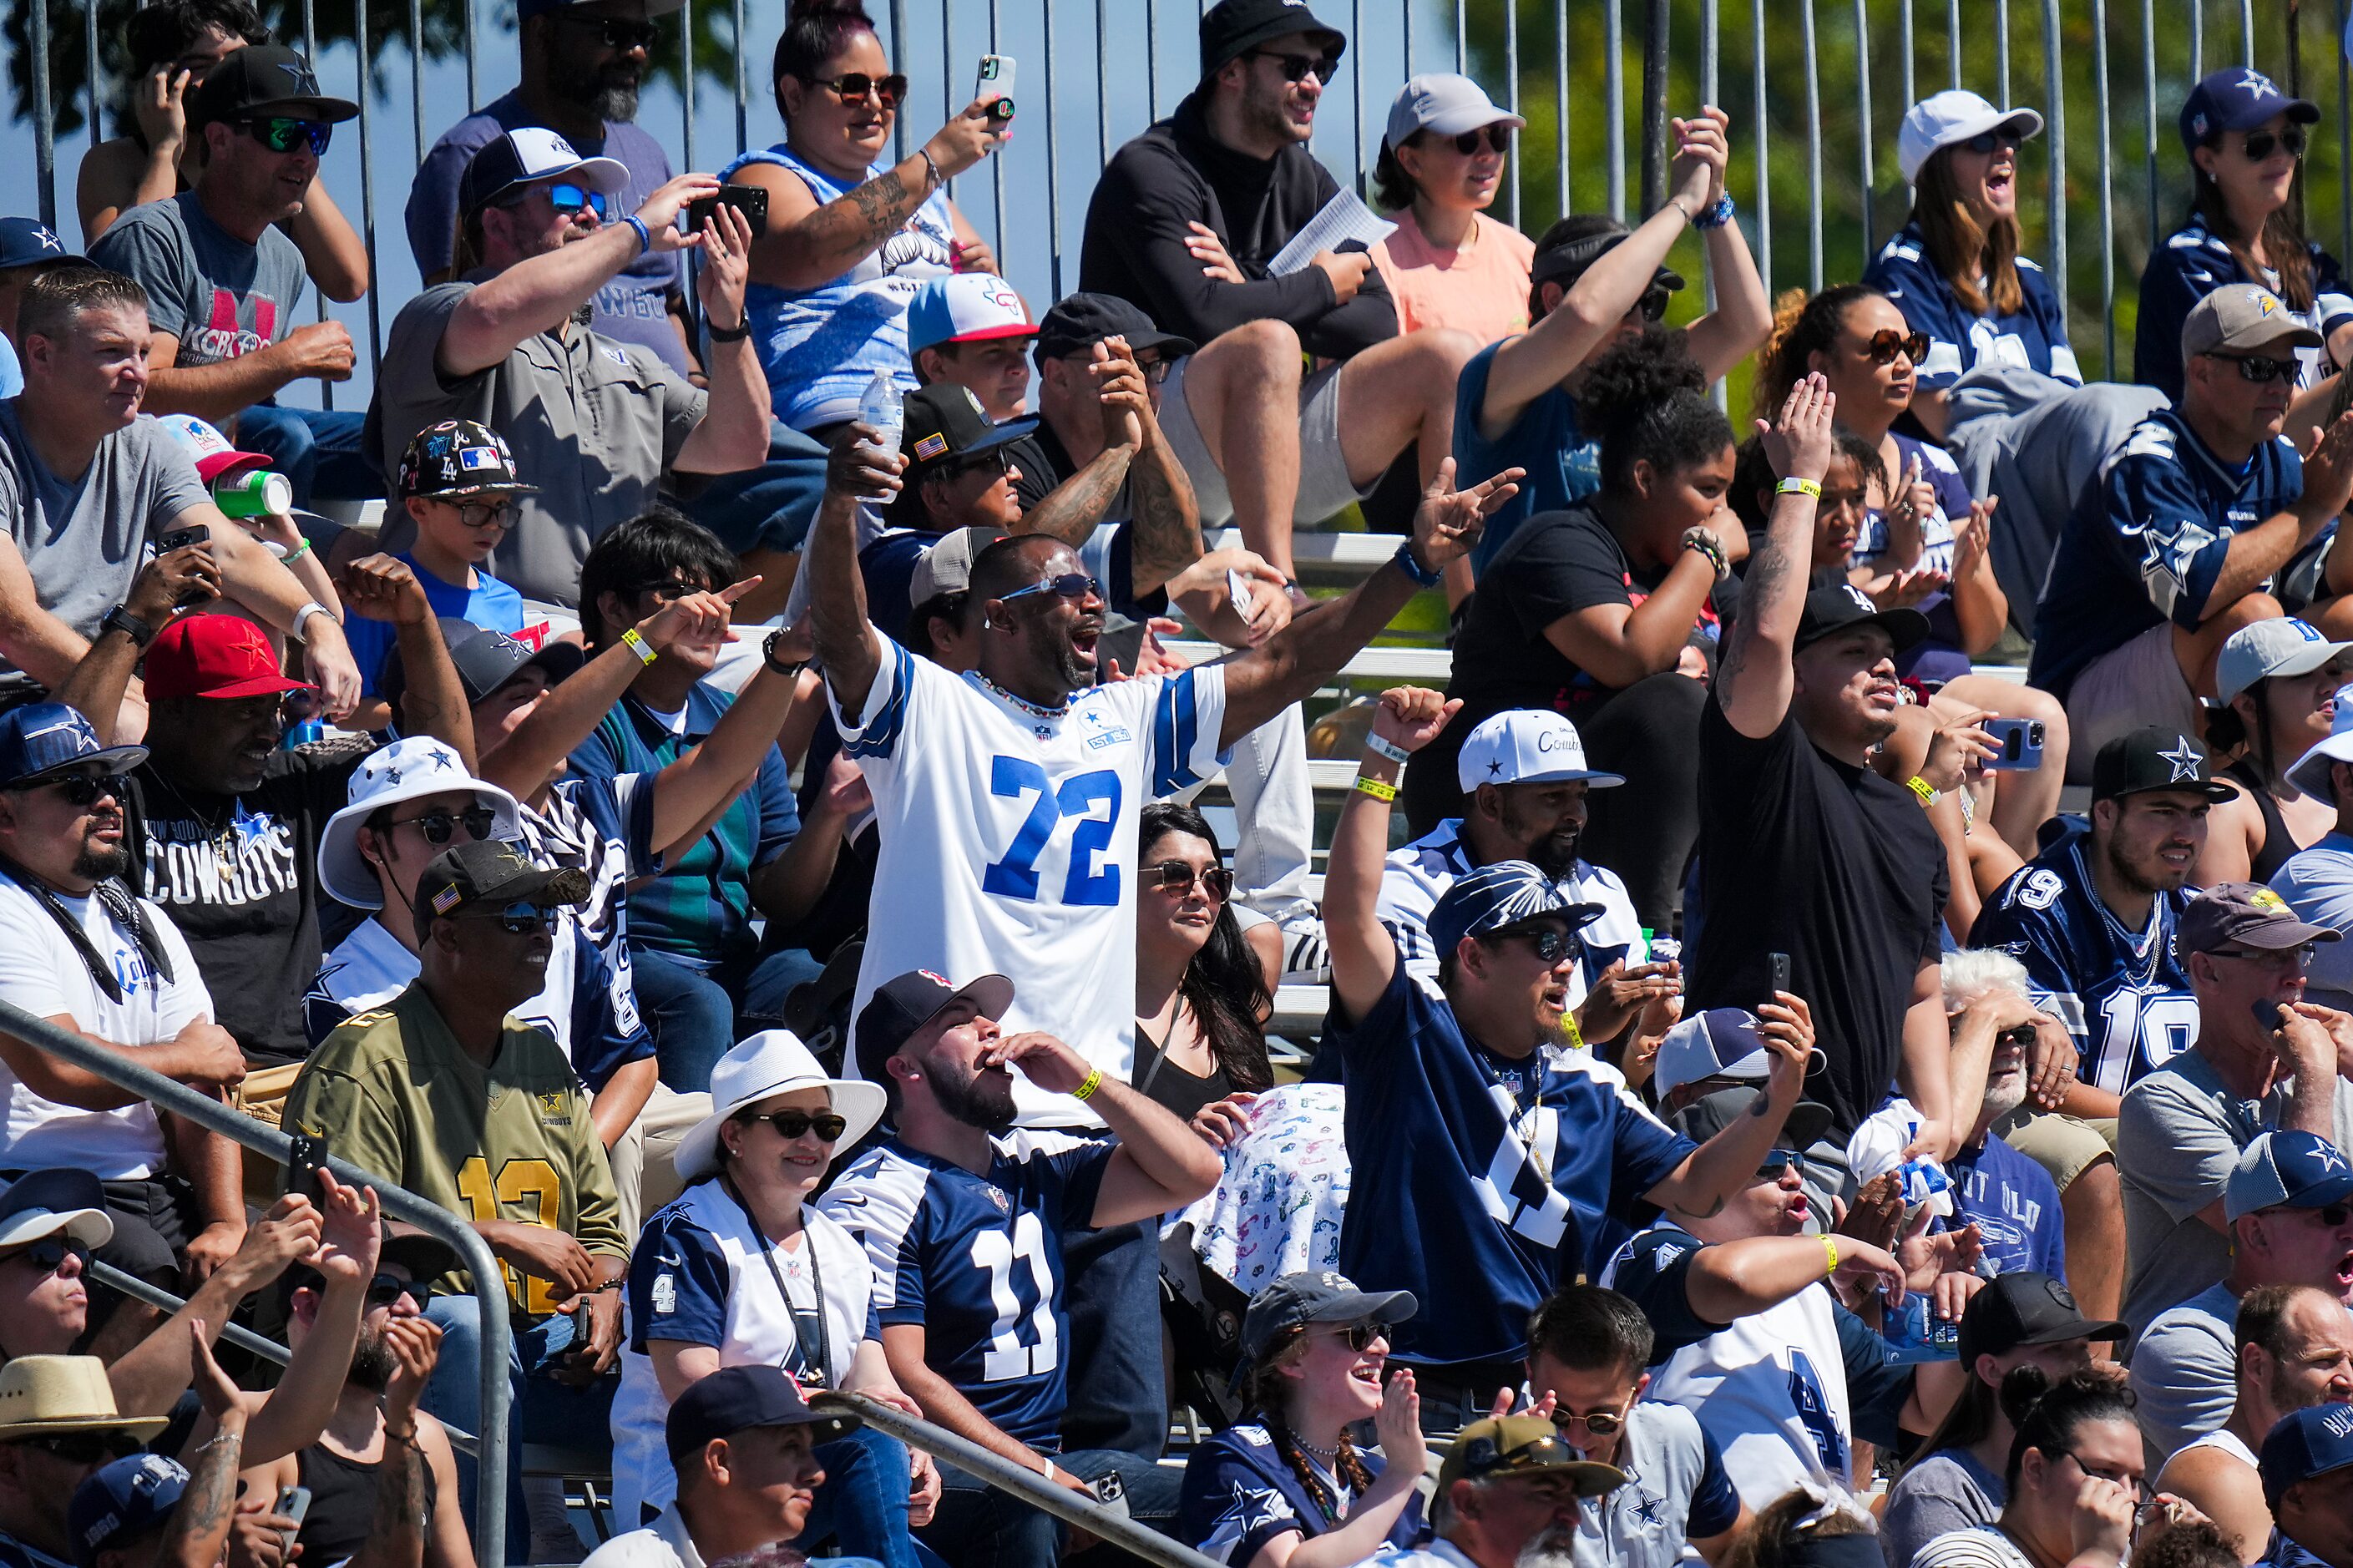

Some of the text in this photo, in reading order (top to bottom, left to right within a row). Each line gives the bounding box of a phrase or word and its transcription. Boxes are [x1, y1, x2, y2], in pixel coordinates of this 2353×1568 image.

[2289, 620, 2320, 641] D
[980, 756, 1121, 905] 72
[145, 822, 299, 905] COWBOYS
[1999, 866, 2067, 911] 19
[542, 1116, 573, 1126] COWBOYS
[2001, 1181, 2042, 1233] OLD
[651, 1274, 677, 1313] 4
[970, 1211, 1057, 1382] 11
